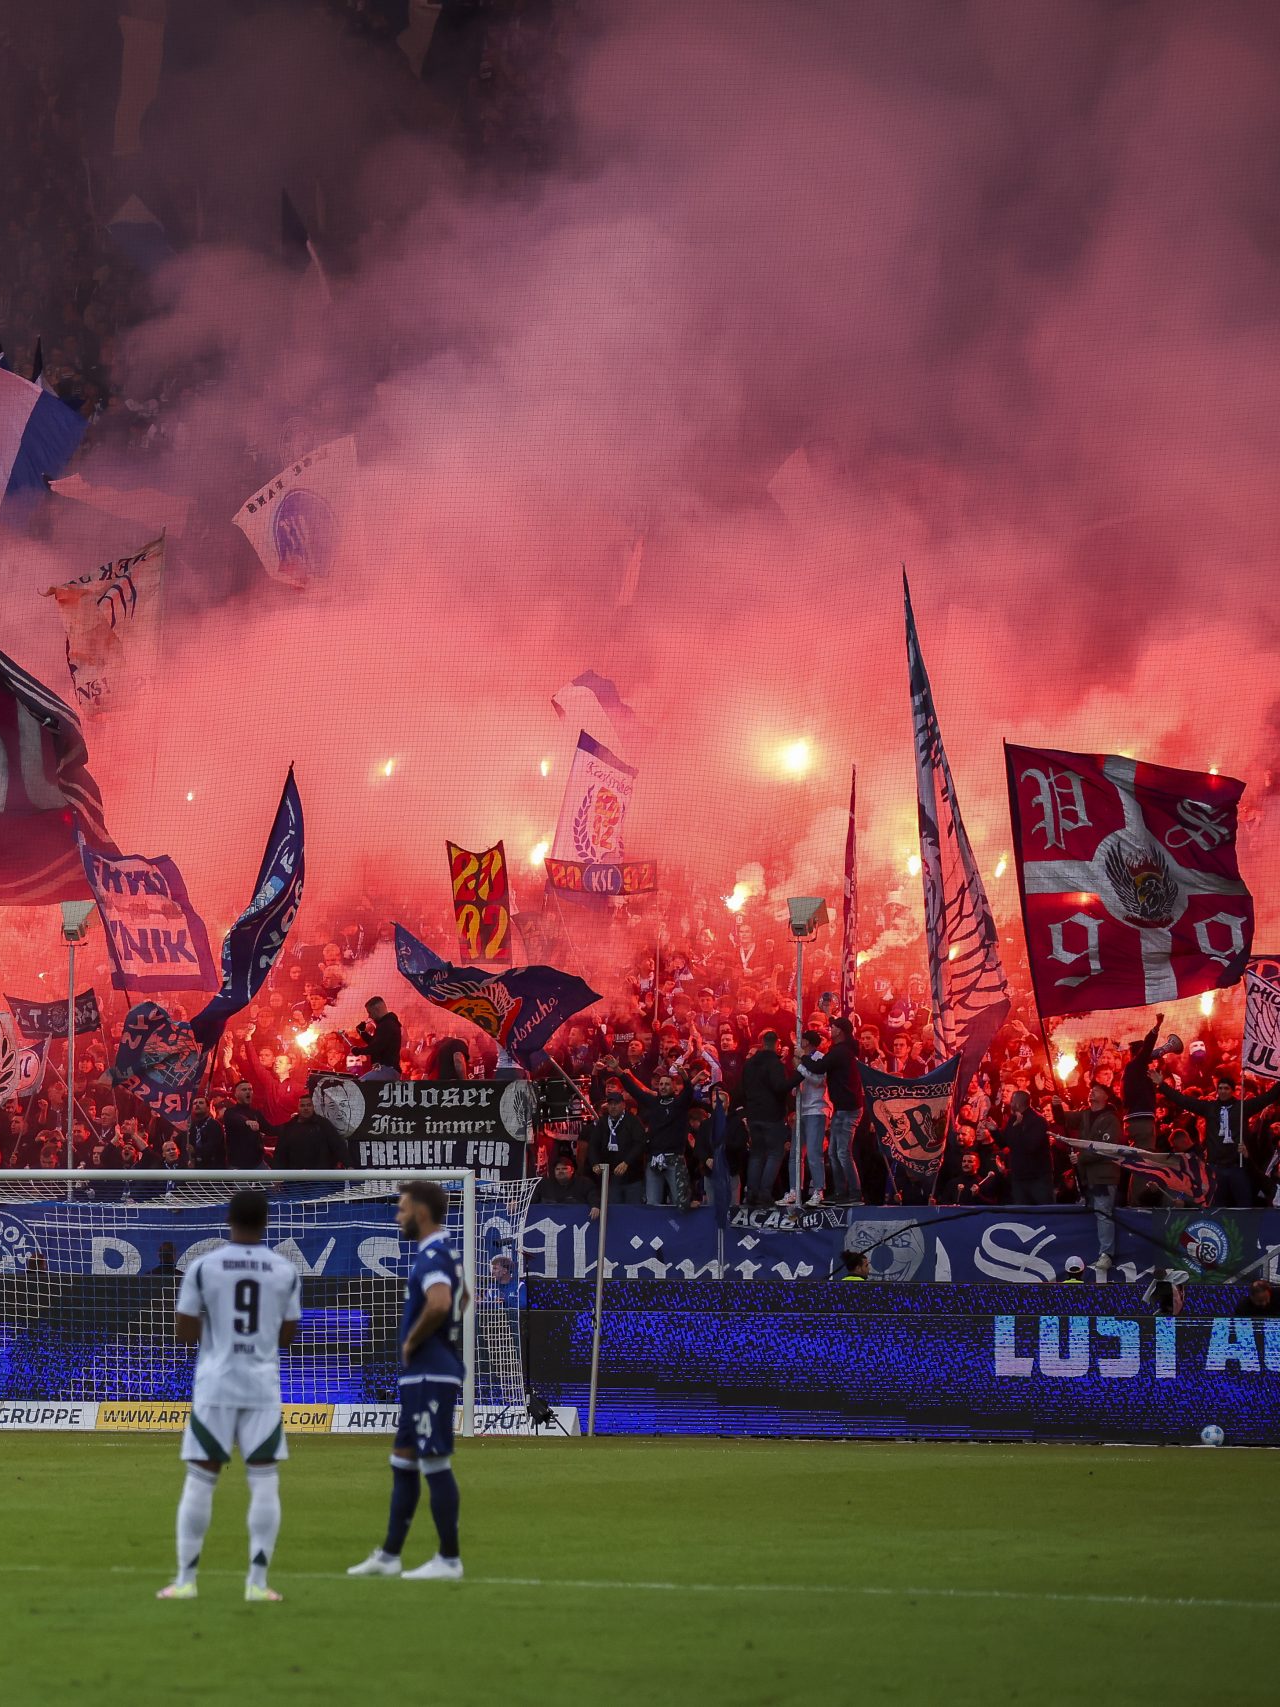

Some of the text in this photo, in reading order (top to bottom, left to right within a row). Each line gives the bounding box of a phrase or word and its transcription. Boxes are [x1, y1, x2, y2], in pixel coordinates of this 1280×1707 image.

[591, 869, 615, 892] KSC
[377, 1081, 494, 1108] Moser
[368, 1114, 496, 1134] Für immer
[359, 1140, 510, 1166] FREIHEIT FÜR
[233, 1279, 261, 1336] 9
